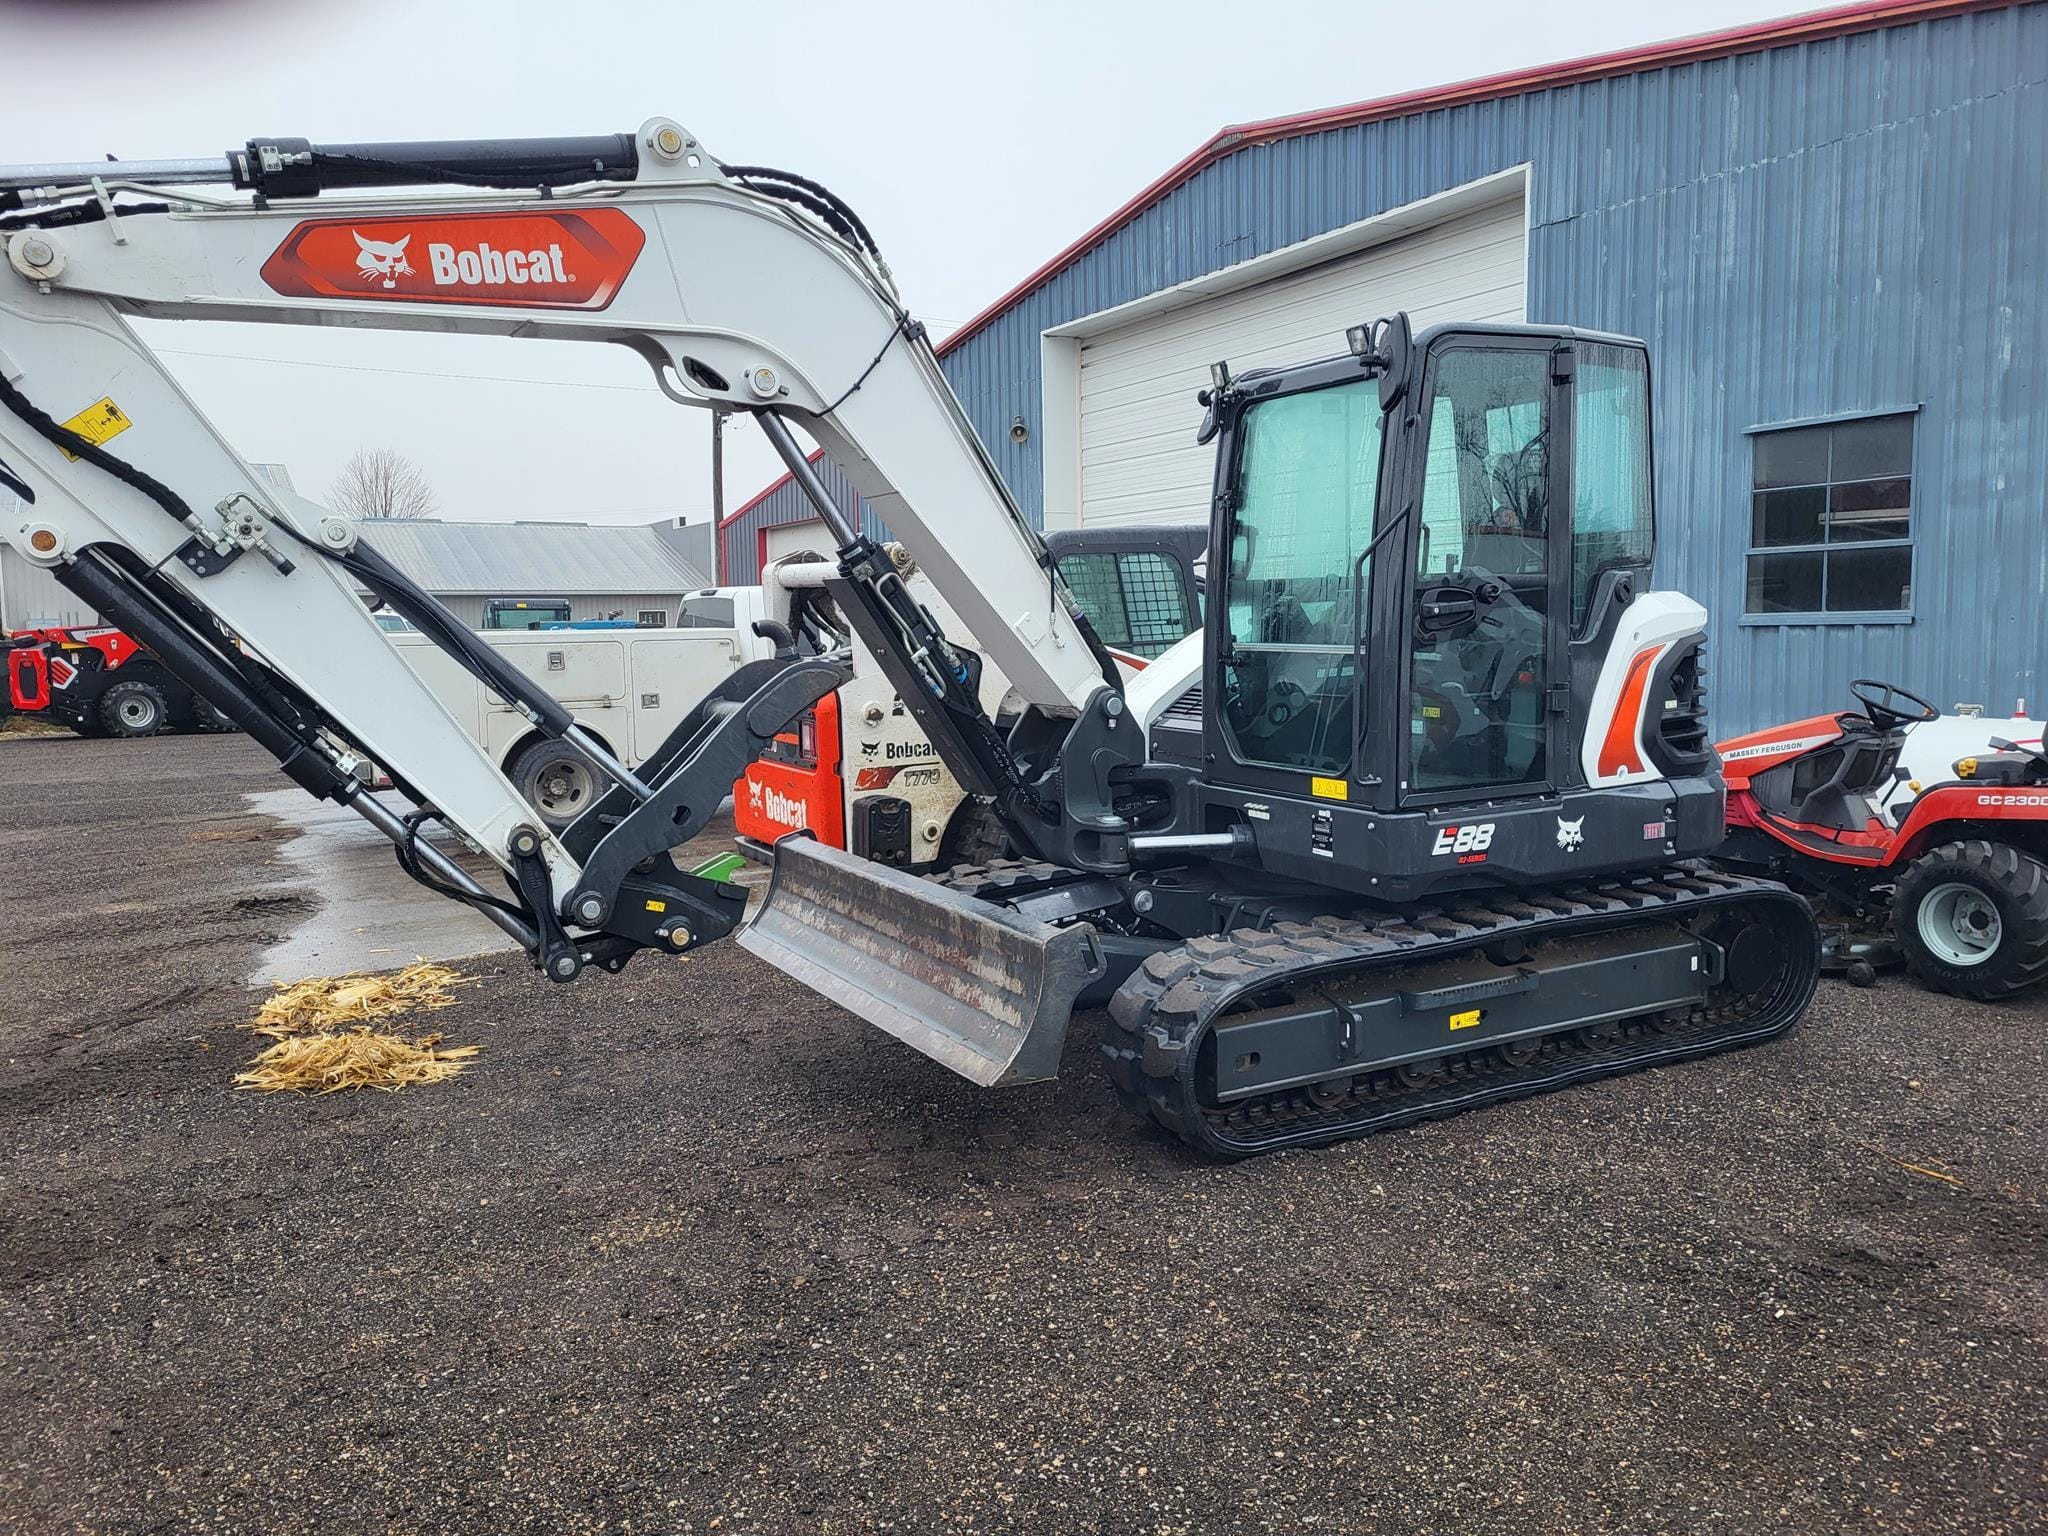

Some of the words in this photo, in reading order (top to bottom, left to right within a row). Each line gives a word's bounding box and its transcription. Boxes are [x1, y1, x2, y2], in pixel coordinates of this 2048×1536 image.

[428, 242, 568, 285] Bobcat
[1729, 748, 1760, 758] MASSEY
[1761, 741, 1803, 754] FERGUSON
[904, 768, 941, 787] T770
[765, 786, 808, 828] Bobcat
[1431, 823, 1496, 856] E88
